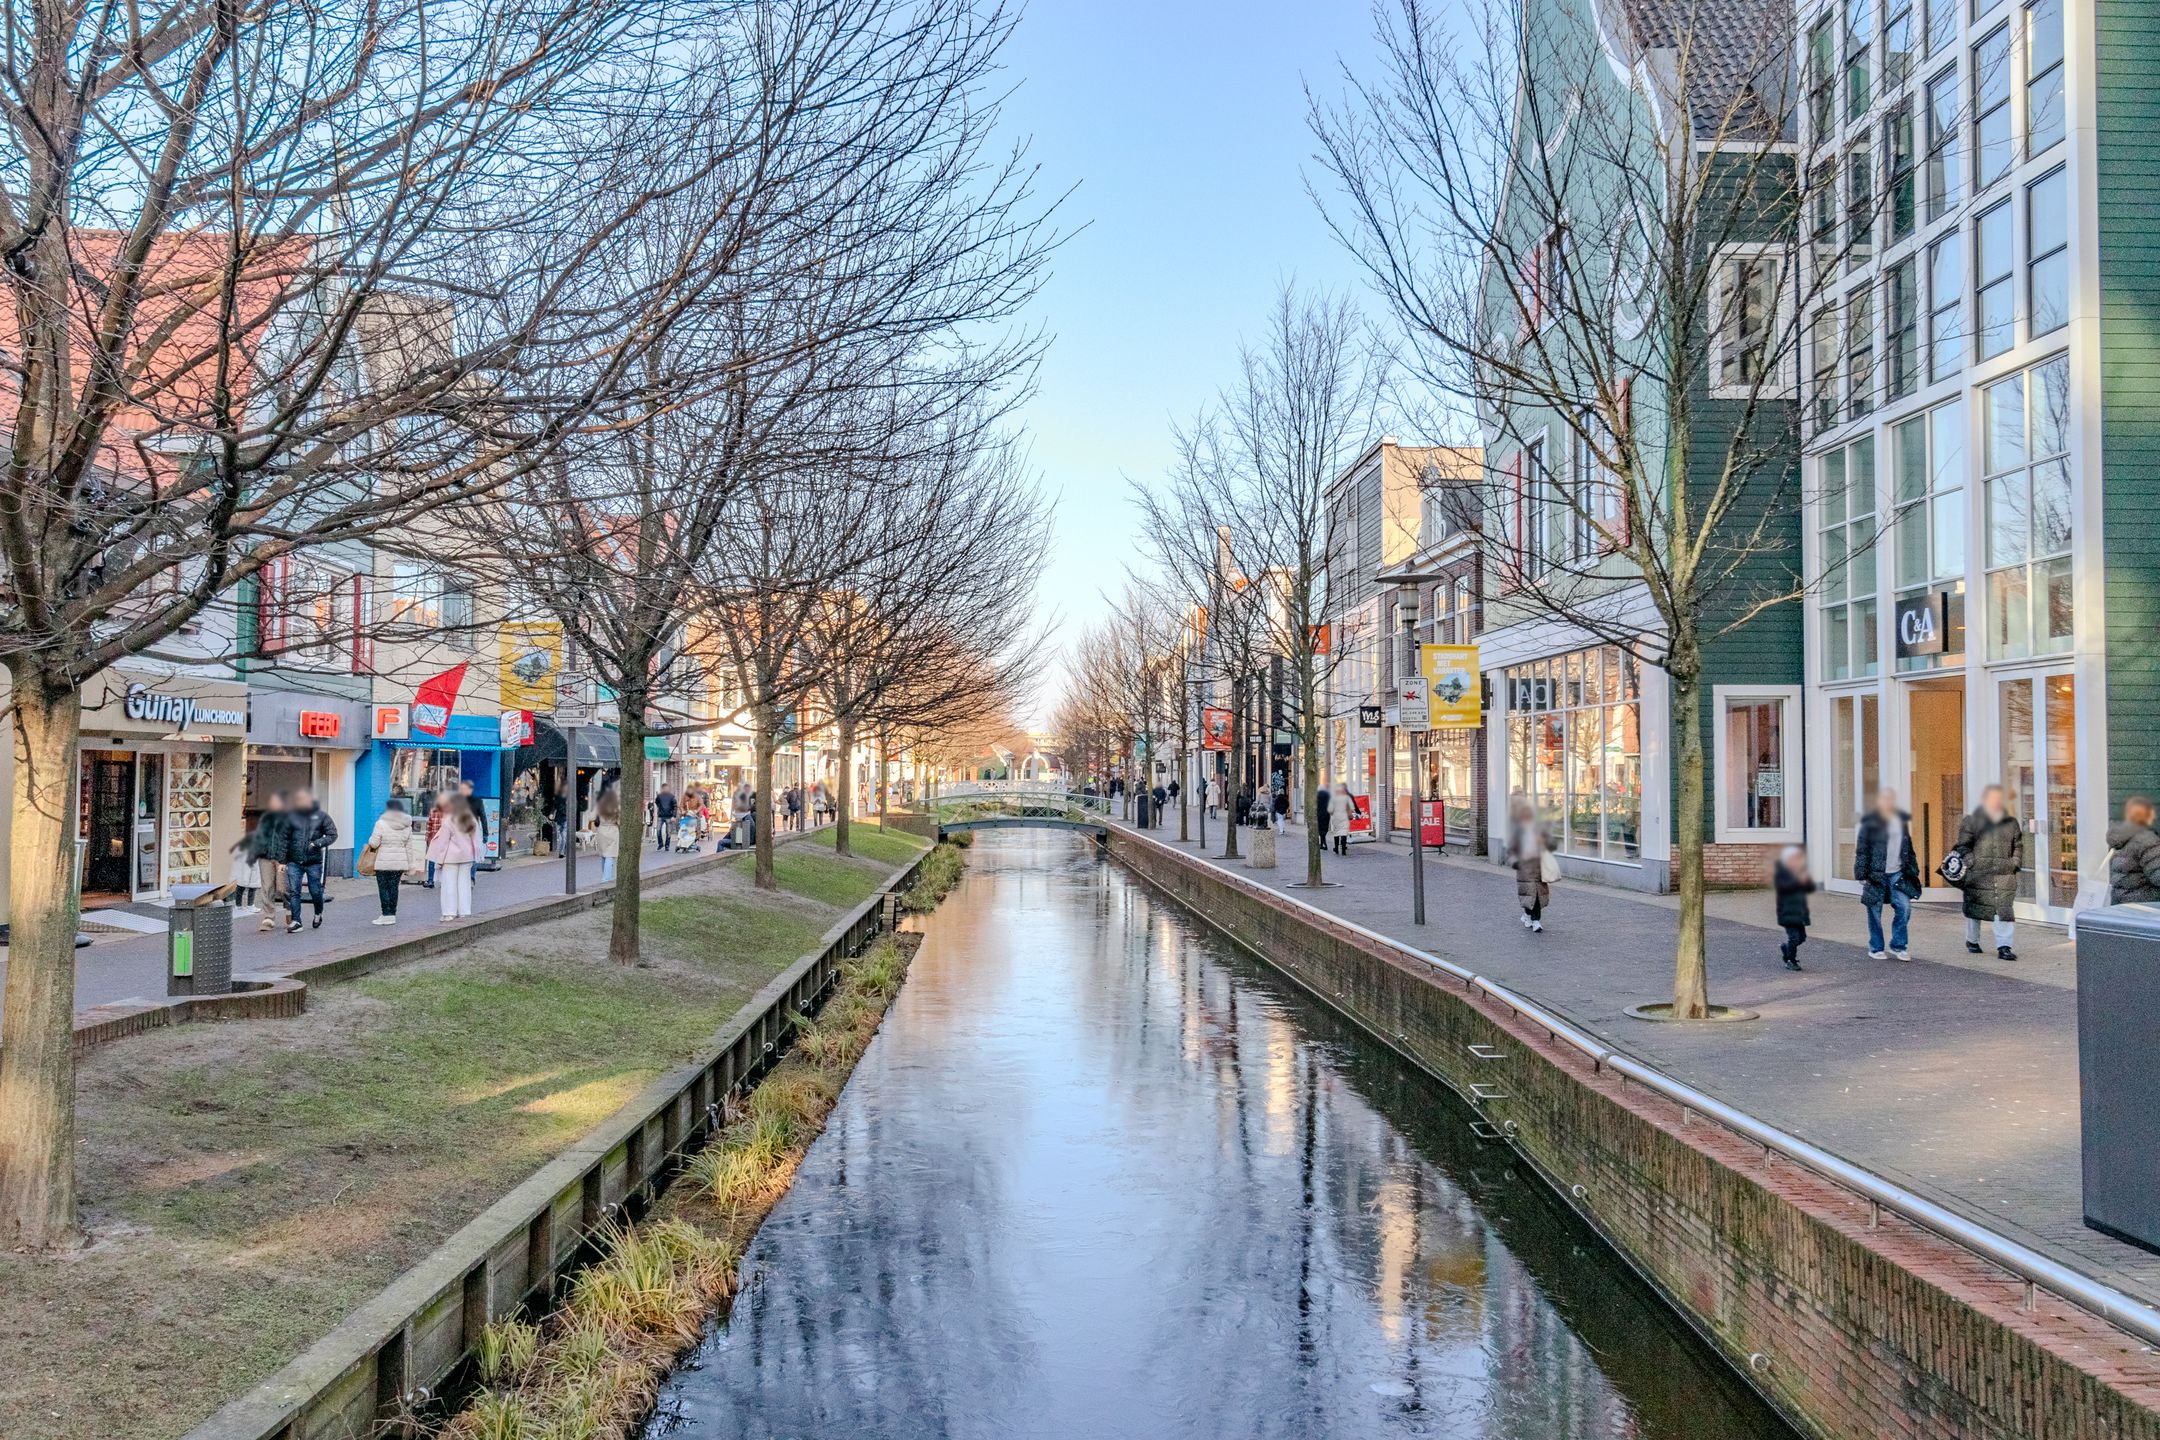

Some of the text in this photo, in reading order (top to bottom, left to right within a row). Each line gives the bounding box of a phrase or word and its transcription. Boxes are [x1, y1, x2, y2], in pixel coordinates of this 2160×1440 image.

[1901, 608, 1936, 645] C&A
[194, 708, 244, 725] LUNCHROOM
[301, 711, 340, 736] FEBO
[377, 708, 400, 734] F
